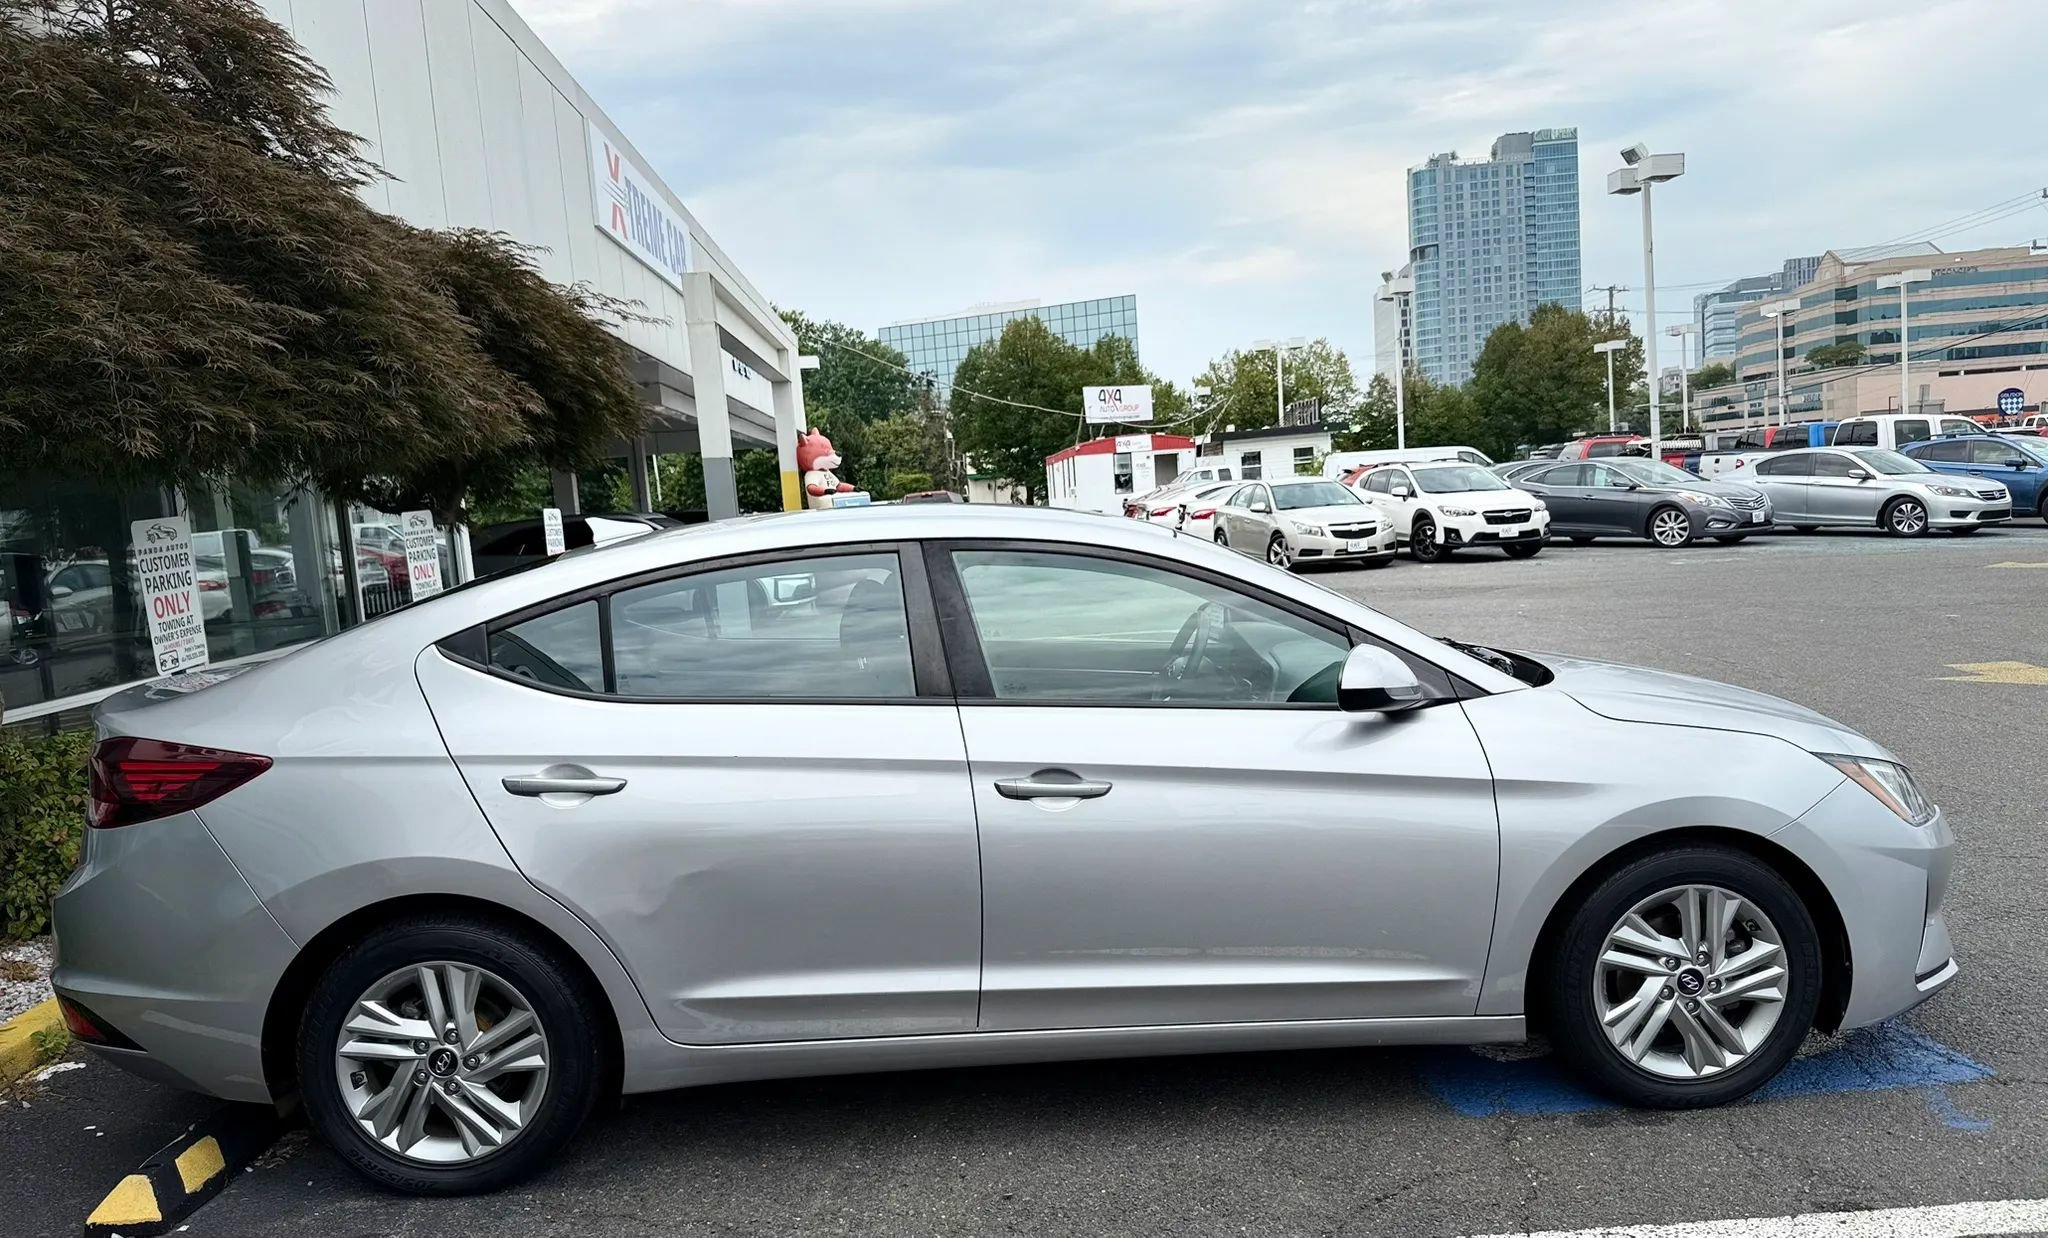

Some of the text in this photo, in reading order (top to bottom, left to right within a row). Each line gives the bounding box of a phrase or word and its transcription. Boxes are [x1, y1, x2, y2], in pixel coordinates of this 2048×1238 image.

[666, 218, 687, 276] CAR
[166, 542, 188, 552] AUTOS
[405, 535, 434, 549] CUSTOMER
[140, 552, 191, 574] CUSTOMER
[409, 548, 436, 563] PARKING
[413, 562, 435, 580] ONLY
[145, 570, 192, 595] PARKING
[153, 590, 190, 619] ONLY
[158, 614, 194, 633] TOWING AT
[154, 624, 202, 646] OWNER'S EXPENSE
